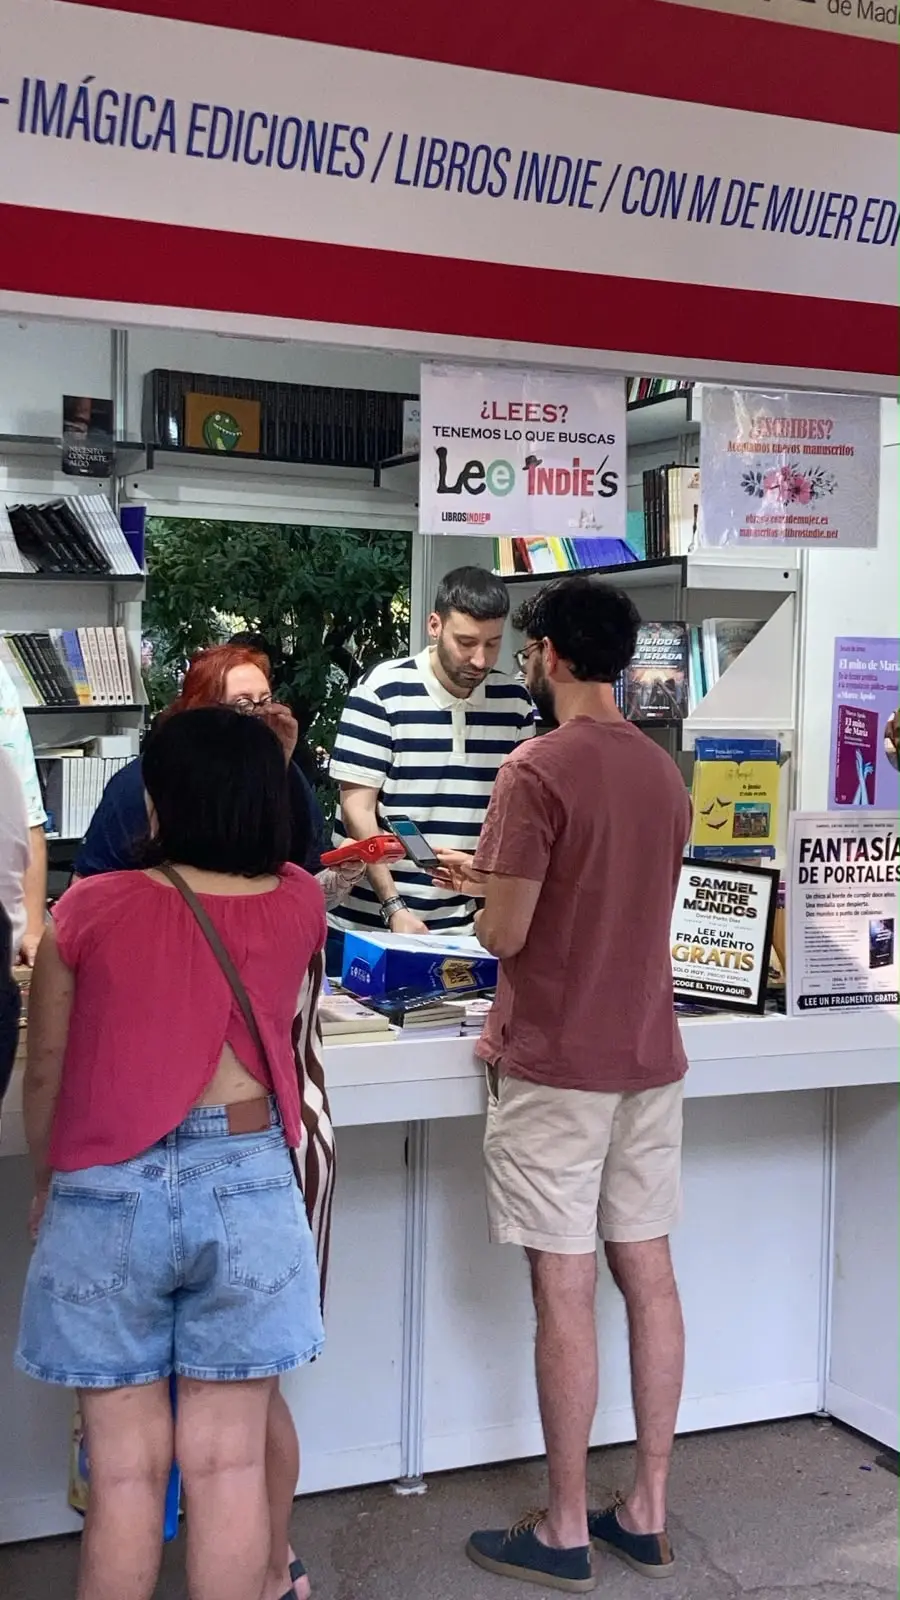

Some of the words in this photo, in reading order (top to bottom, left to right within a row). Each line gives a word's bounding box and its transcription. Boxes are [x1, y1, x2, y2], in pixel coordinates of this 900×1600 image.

[828, 0, 852, 16] de
[17, 75, 177, 154] IMÁGICA
[186, 102, 369, 179] EDICIONES
[394, 133, 511, 198] LIBROS
[513, 150, 602, 210] INDIE
[621, 166, 688, 221] CON
[687, 174, 721, 224] M
[720, 178, 764, 230] DE
[762, 185, 859, 242] MUJER
[480, 400, 569, 424] ¿LEES?
[432, 425, 502, 440] TENEMOS
[504, 430, 522, 441] LO
[525, 430, 555, 442] QUE
[558, 432, 616, 445] BUSCAS
[772, 443, 801, 455] nuevos
[803, 444, 855, 457] manuscritos
[868, 659, 878, 671] de
[799, 867, 819, 884] DE
[824, 865, 900, 884] PORTALES
[689, 875, 758, 896] SAMUEL
[695, 888, 749, 906] ENTRE
[682, 898, 758, 919] MUNDOS
[676, 932, 754, 952] FRAGMENTO
[697, 927, 717, 936] LEE
[719, 930, 734, 939] UN
[671, 943, 755, 972] GRATIS
[706, 984, 725, 992] TUYO
[804, 997, 818, 1007] LEE
[819, 996, 830, 1006] UN
[831, 994, 873, 1005] FRAGMENTO
[874, 993, 898, 1003] GRATIS
